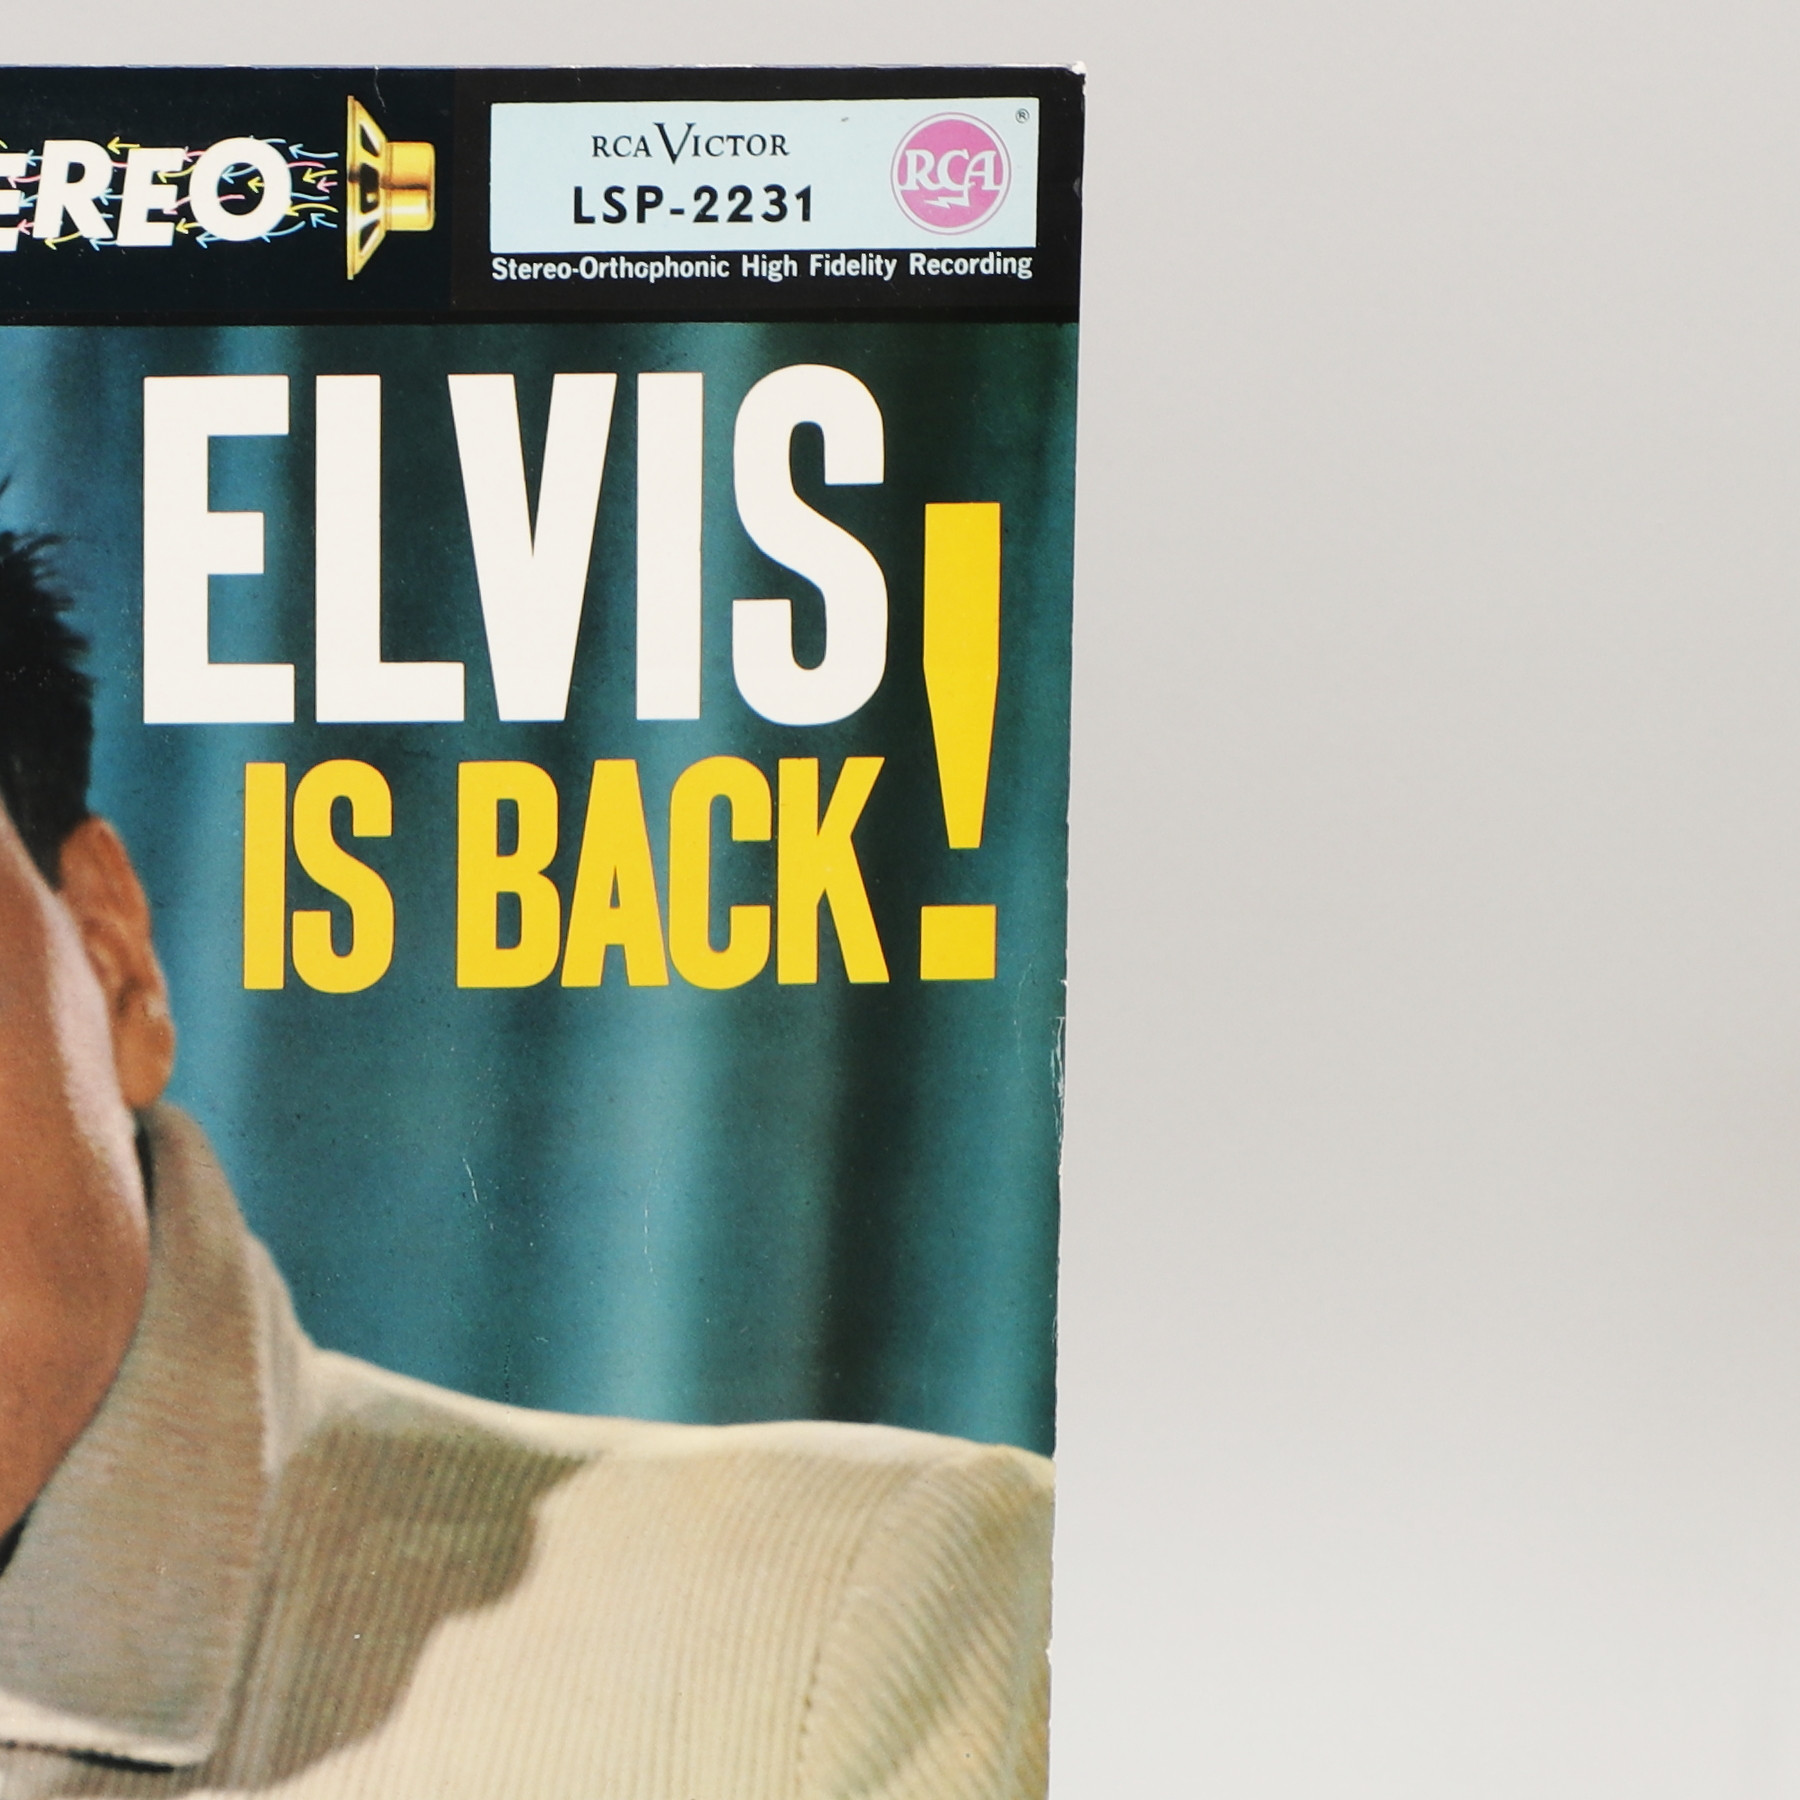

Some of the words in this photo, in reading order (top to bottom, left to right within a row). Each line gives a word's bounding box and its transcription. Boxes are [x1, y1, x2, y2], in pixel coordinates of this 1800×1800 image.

[591, 134, 652, 158] RCA
[901, 149, 1001, 205] RCA
[573, 185, 812, 224] LSP-2231
[492, 254, 730, 283] Stereo-Orthophonic
[741, 254, 798, 281] High
[809, 252, 897, 281] Fidelity
[909, 252, 1033, 279] Recording
[143, 364, 888, 726] ELVIS
[243, 759, 394, 994] IS
